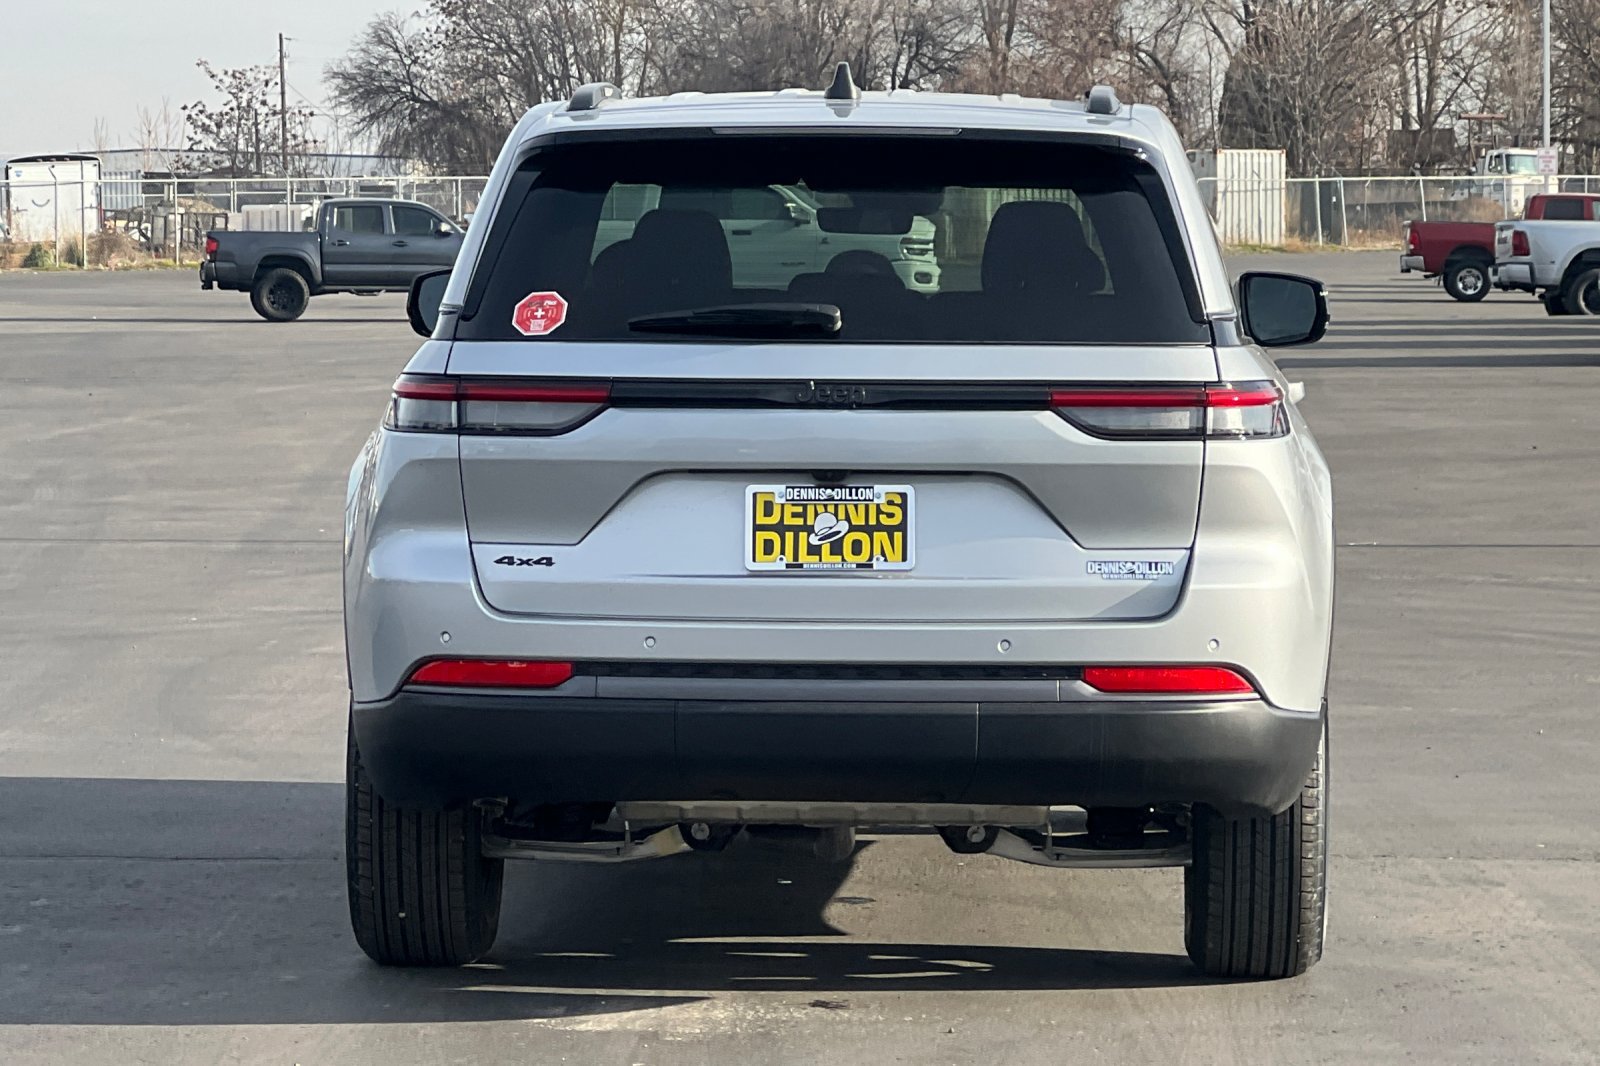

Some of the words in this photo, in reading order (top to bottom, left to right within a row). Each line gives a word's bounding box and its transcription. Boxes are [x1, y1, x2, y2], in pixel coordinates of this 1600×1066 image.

[795, 381, 866, 409] Jeep
[786, 488, 826, 500] DENNIS
[834, 488, 873, 500] DILLON
[755, 531, 903, 563] DILLON
[493, 555, 556, 567] 4x4
[1087, 561, 1126, 574] DENNIS
[1134, 561, 1173, 575] DILLON
